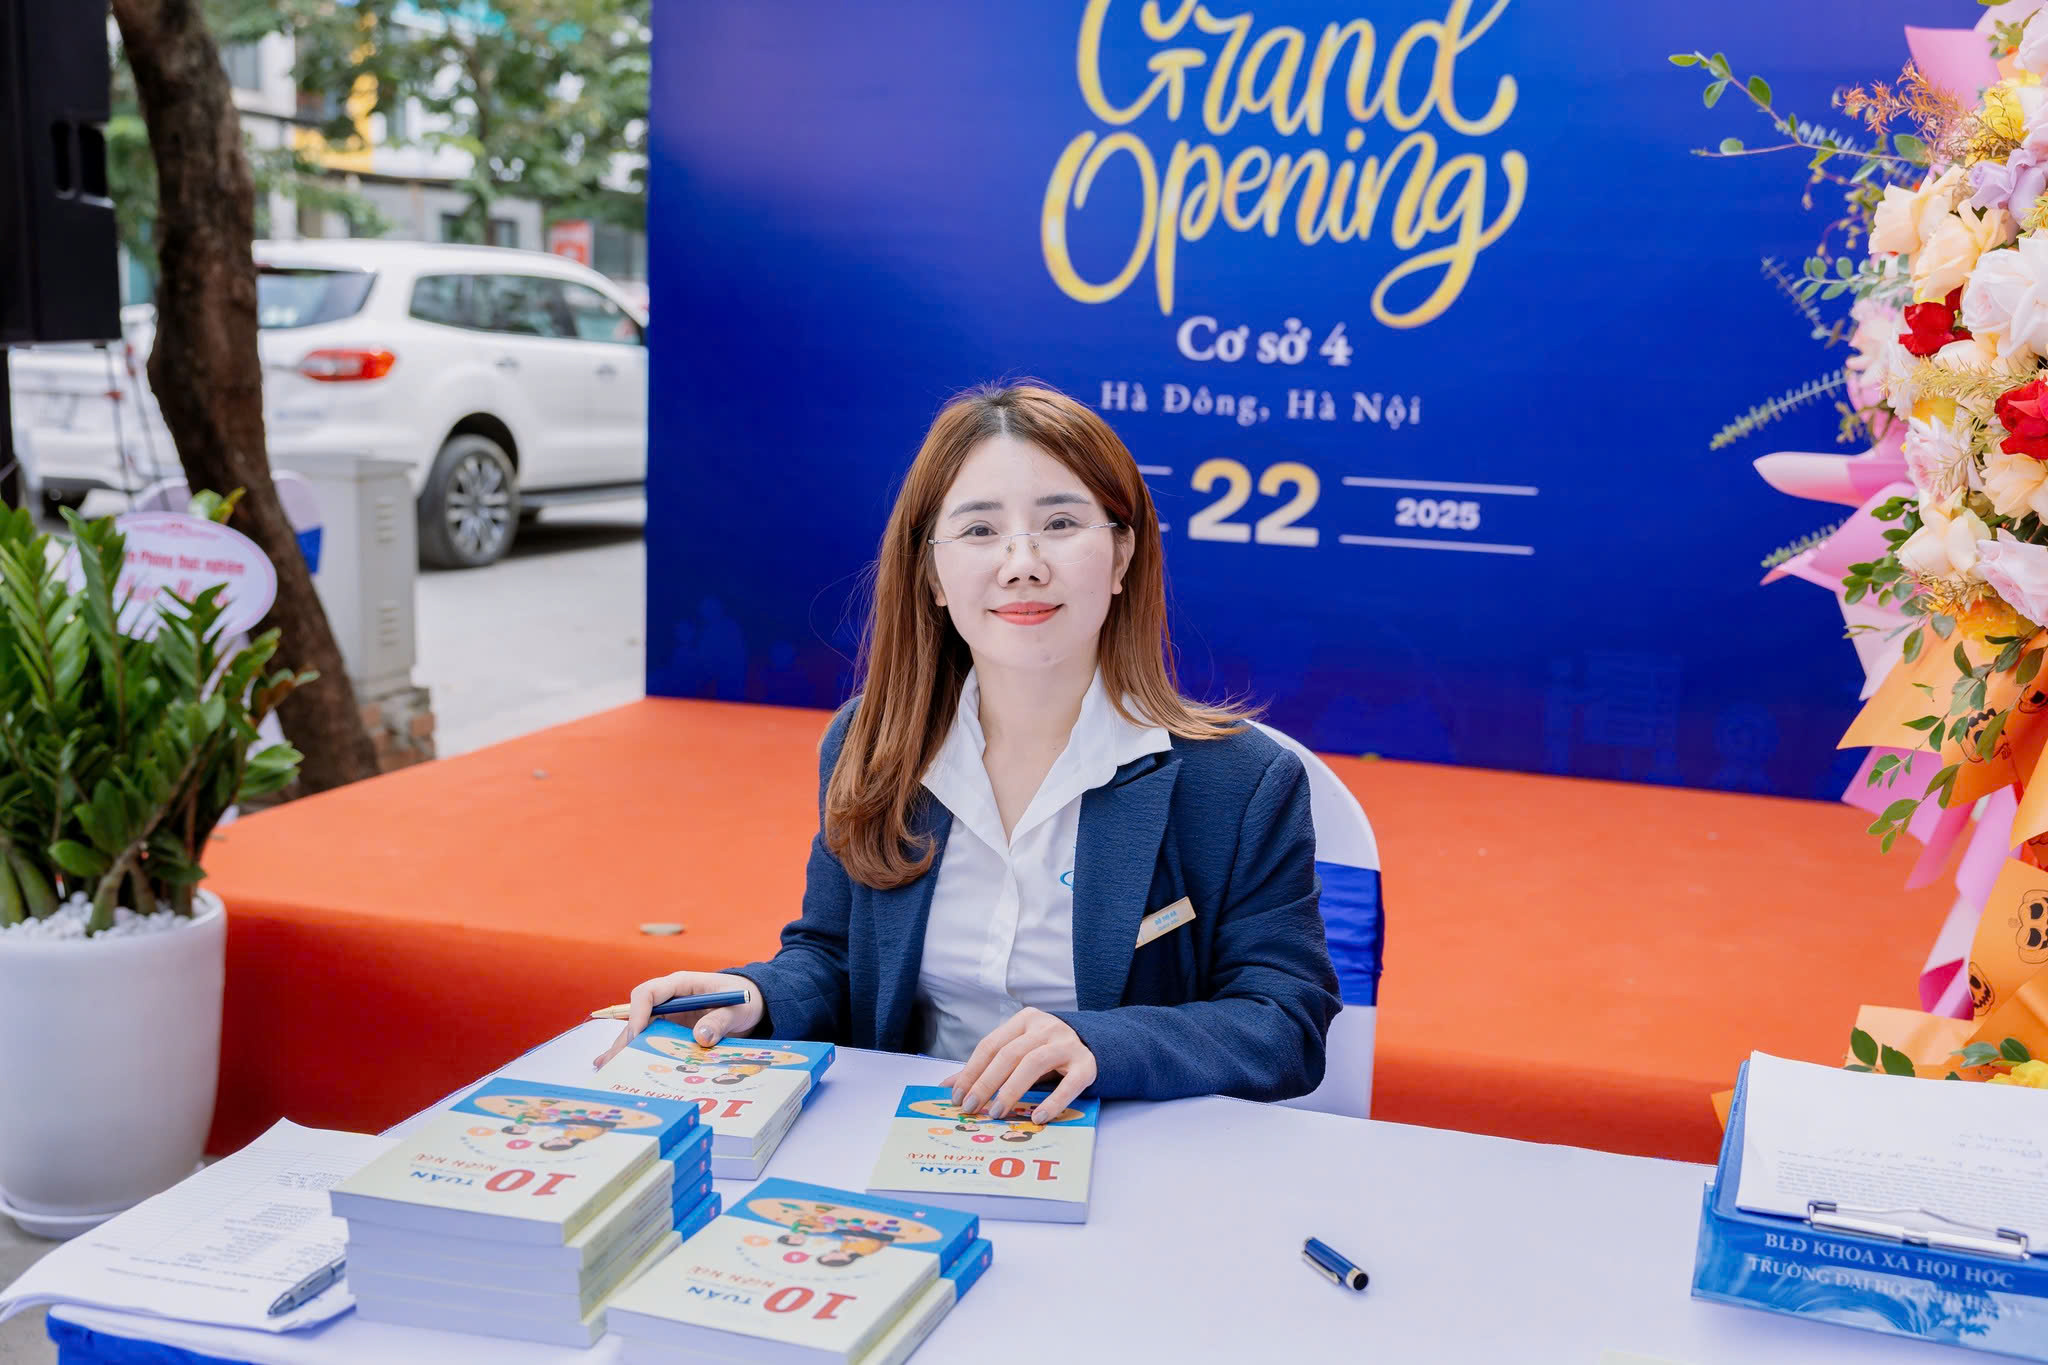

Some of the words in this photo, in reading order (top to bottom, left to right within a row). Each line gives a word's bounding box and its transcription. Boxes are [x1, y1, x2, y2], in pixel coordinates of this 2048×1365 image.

[1076, 0, 1518, 137] Grand
[1041, 129, 1528, 329] Opening
[1176, 315, 1250, 363] Cơ
[1256, 317, 1312, 365] sở
[1319, 321, 1354, 367] 4
[1101, 379, 1148, 413] Hà
[1286, 388, 1337, 422] Hà
[1188, 457, 1321, 548] 22
[1394, 496, 1481, 531] 2025
[484, 1168, 577, 1197] 10
[988, 1156, 1061, 1181] 10
[1813, 1240, 1876, 1266] KHOA
[763, 1286, 857, 1320] 10
